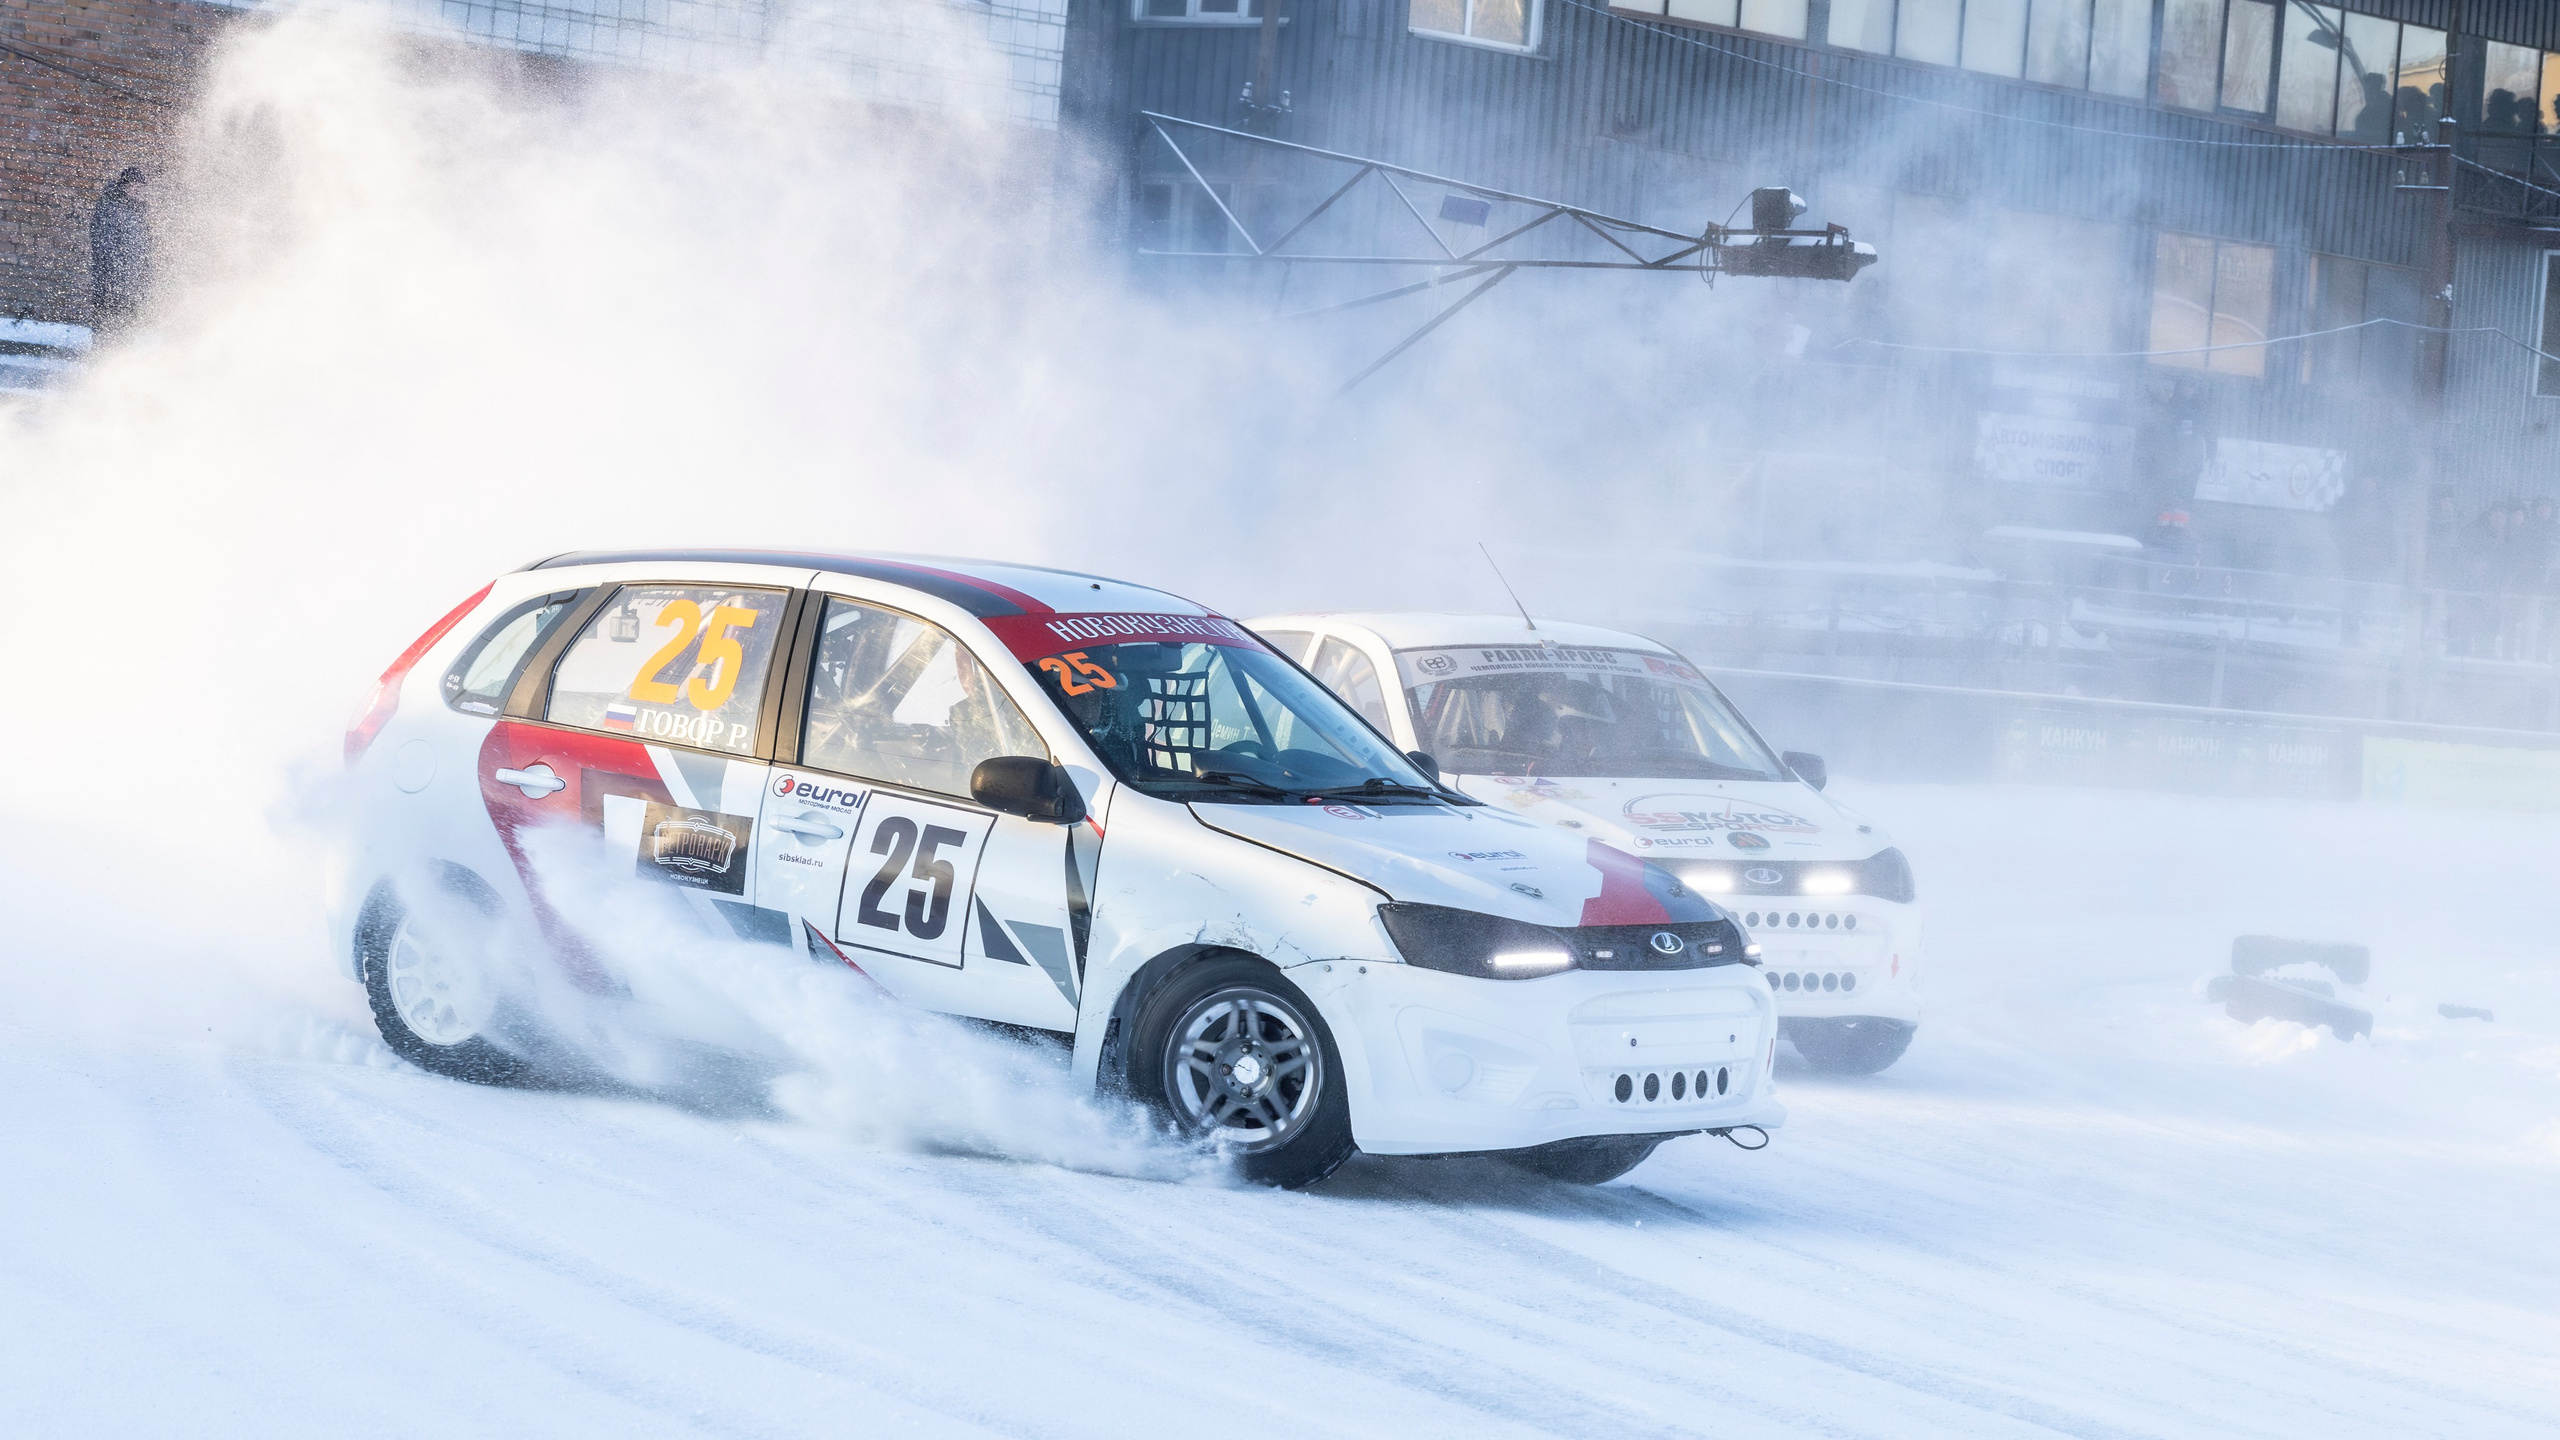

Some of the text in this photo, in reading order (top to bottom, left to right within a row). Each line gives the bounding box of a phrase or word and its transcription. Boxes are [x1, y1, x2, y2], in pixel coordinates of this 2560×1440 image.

[2033, 457, 2085, 478] СПОРТ
[1045, 615, 1247, 642] НОВОКУЗНЕЦК
[629, 599, 759, 711] 25
[1481, 649, 1618, 664] РАЛЛИ-КРОСС
[1039, 652, 1117, 696] 25
[637, 708, 748, 749] ГОВОР Р.
[2041, 726, 2107, 750] КАНКУН
[2158, 735, 2220, 758] КАНКУН
[2267, 743, 2329, 766] КАНКУН
[796, 782, 867, 809] eurol
[798, 799, 852, 815] моторные масла
[661, 831, 729, 864] РЕТРОПАРК
[1654, 836, 1715, 846] eurol
[778, 853, 823, 867] sibsklad.ru
[670, 873, 709, 885] НОВОКУЗНЕЦК
[857, 816, 967, 940] 25
